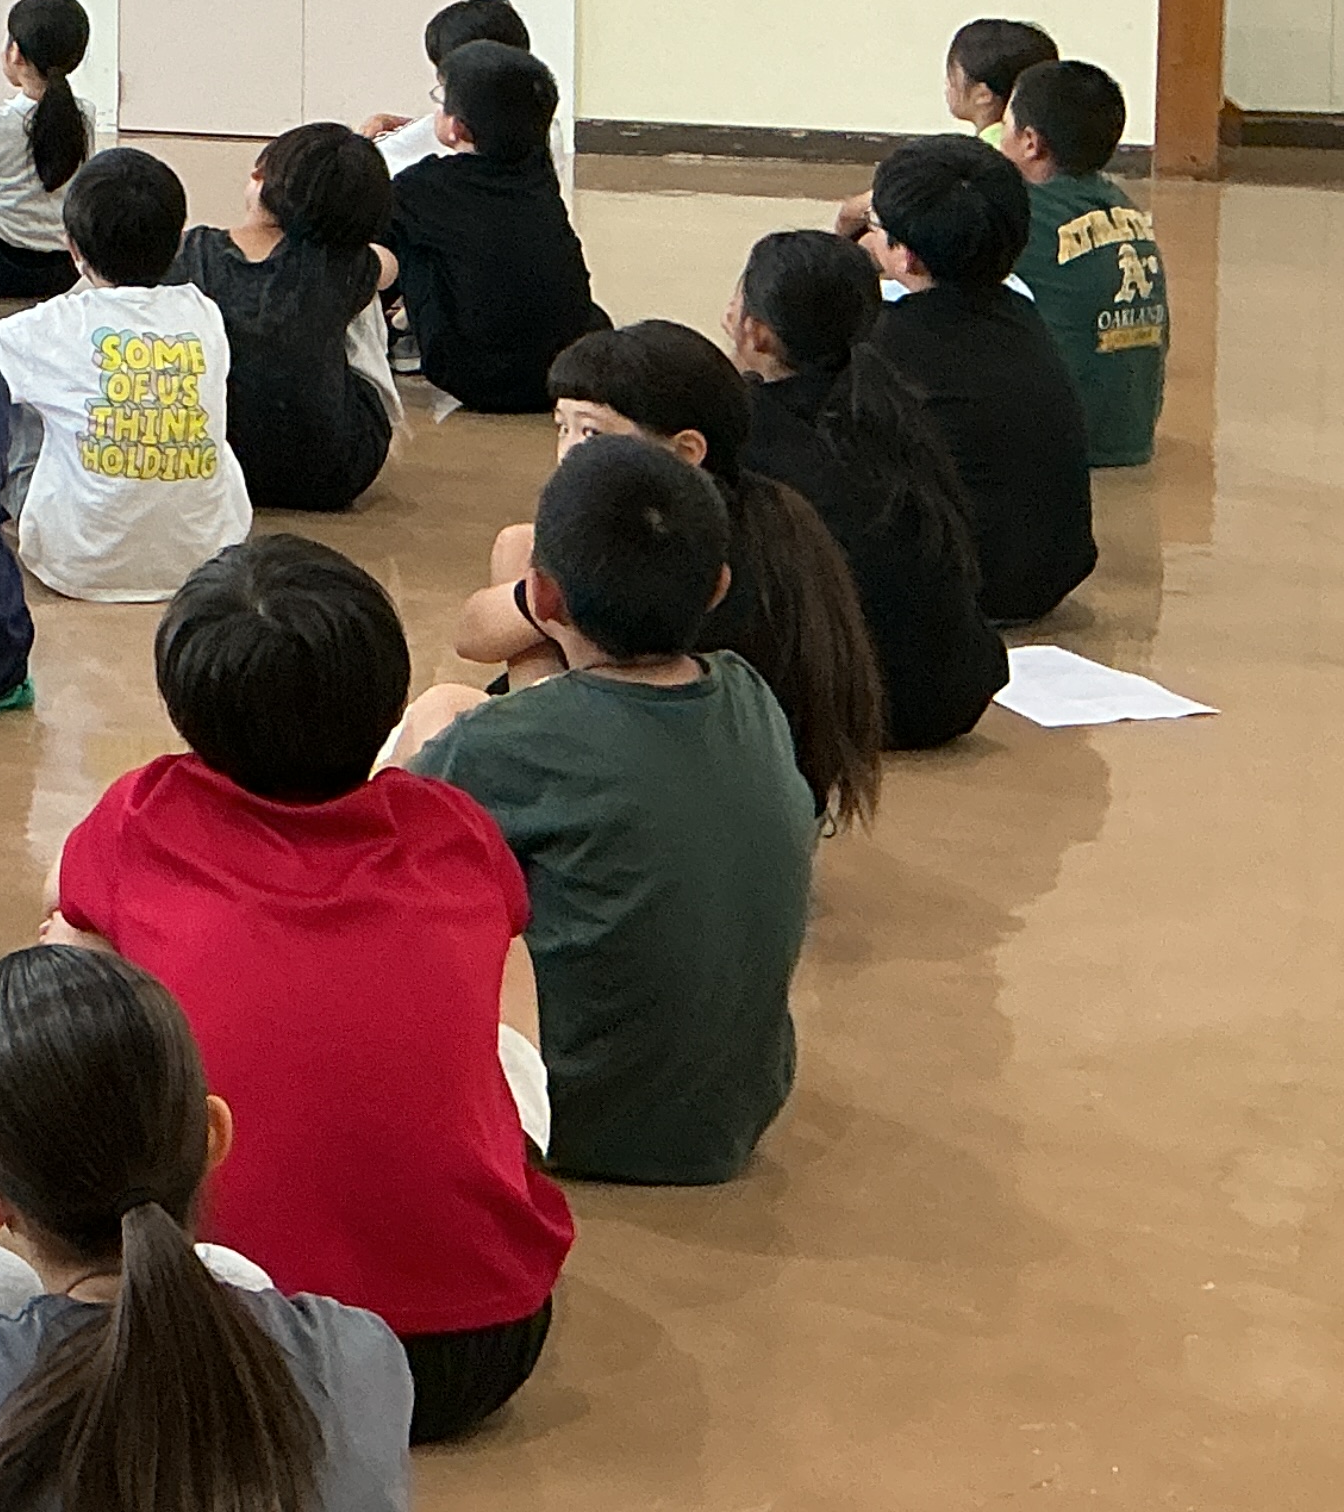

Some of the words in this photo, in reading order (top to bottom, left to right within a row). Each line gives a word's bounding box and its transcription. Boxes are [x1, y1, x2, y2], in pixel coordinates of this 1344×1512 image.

[92, 327, 206, 374] SOME
[101, 372, 150, 404] OF
[152, 372, 201, 407] US
[86, 399, 210, 445] THINK
[79, 436, 219, 482] HOLDING
